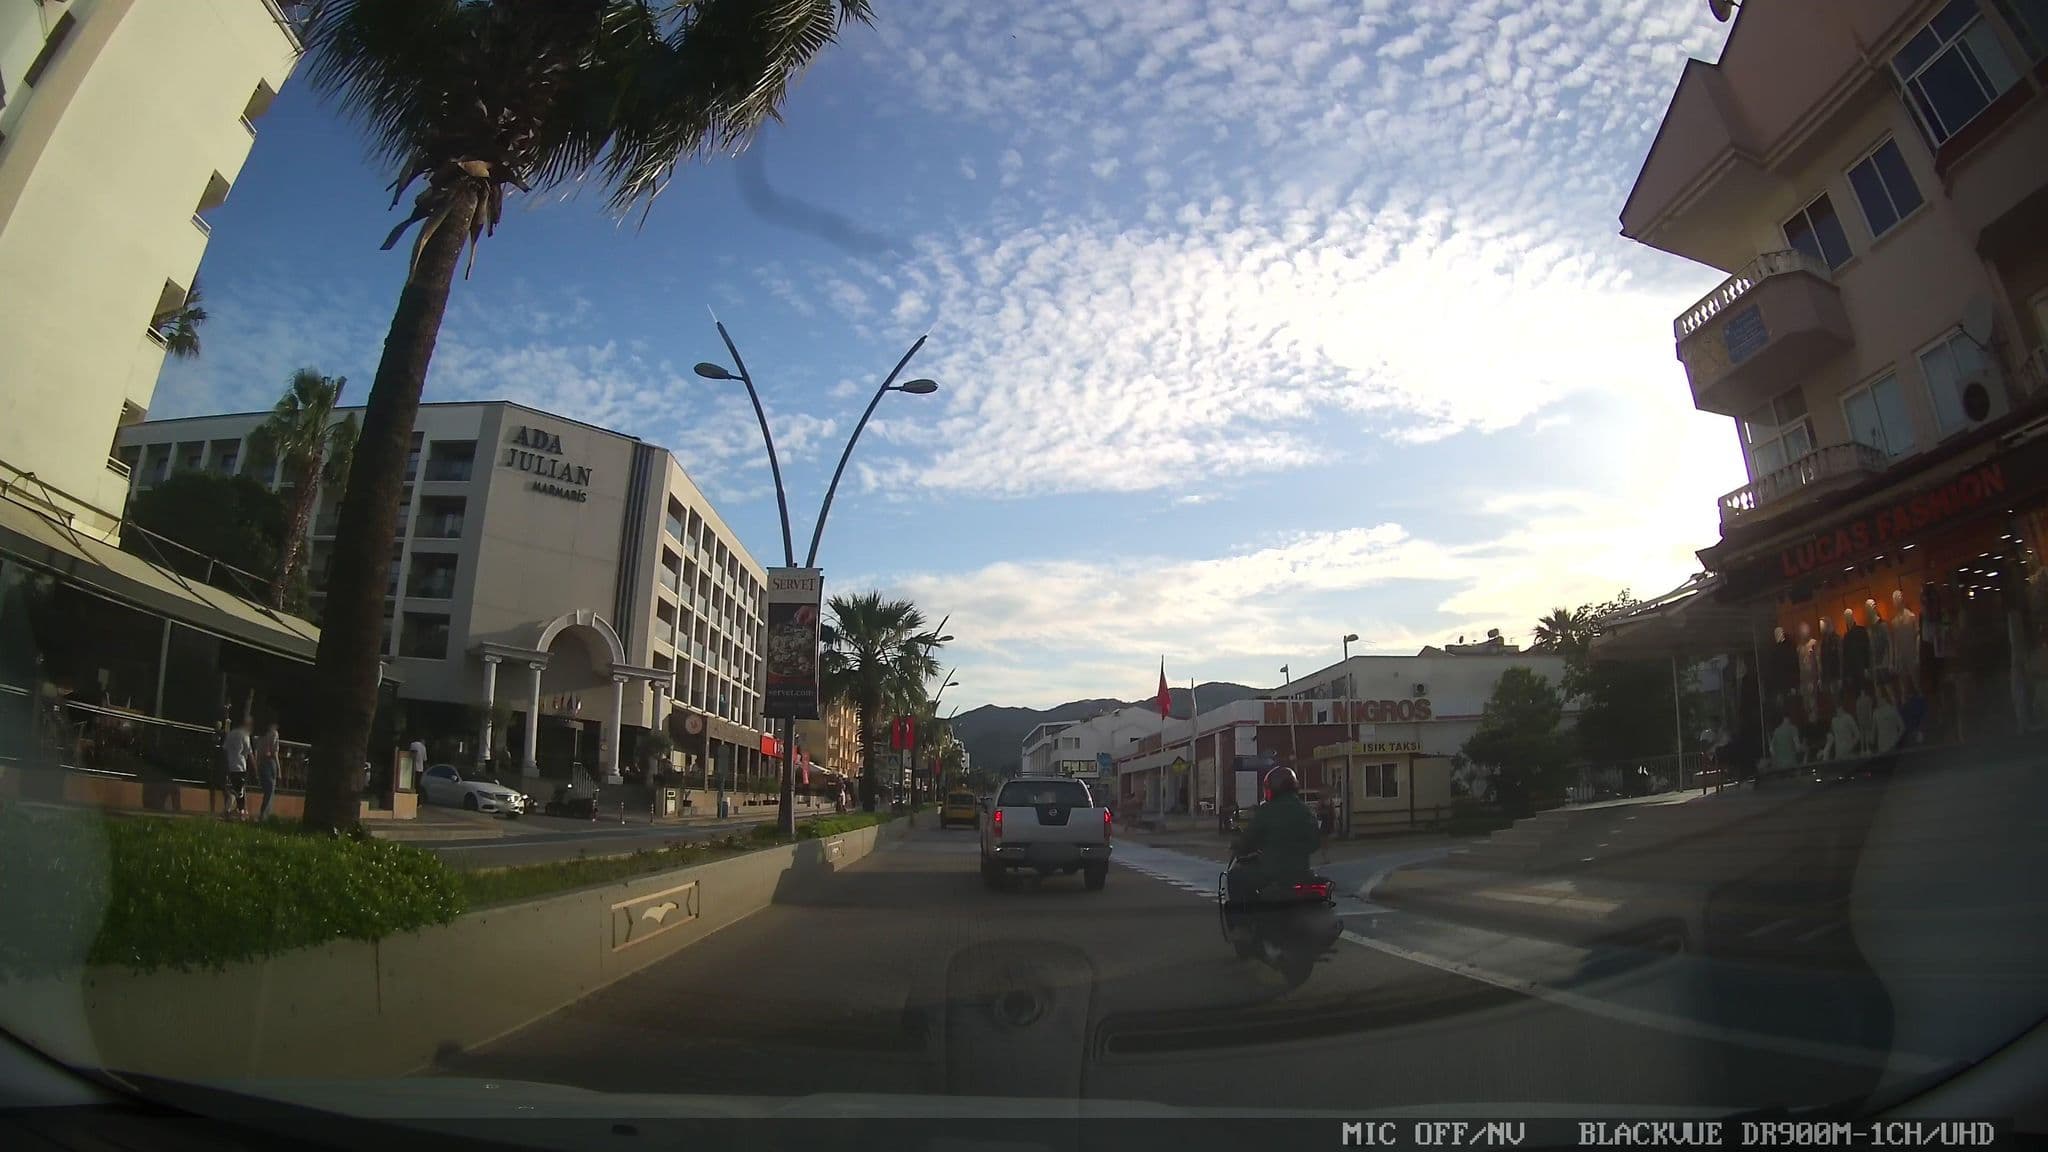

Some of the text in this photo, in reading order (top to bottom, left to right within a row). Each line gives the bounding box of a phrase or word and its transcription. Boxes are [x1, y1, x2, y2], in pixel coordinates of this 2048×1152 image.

[513, 426, 562, 455] ADA
[507, 448, 592, 486] JULIAN
[1779, 463, 2008, 578] LUCAS FASHION
[772, 578, 816, 591] SERVET
[1333, 699, 1432, 722] MIGROS
